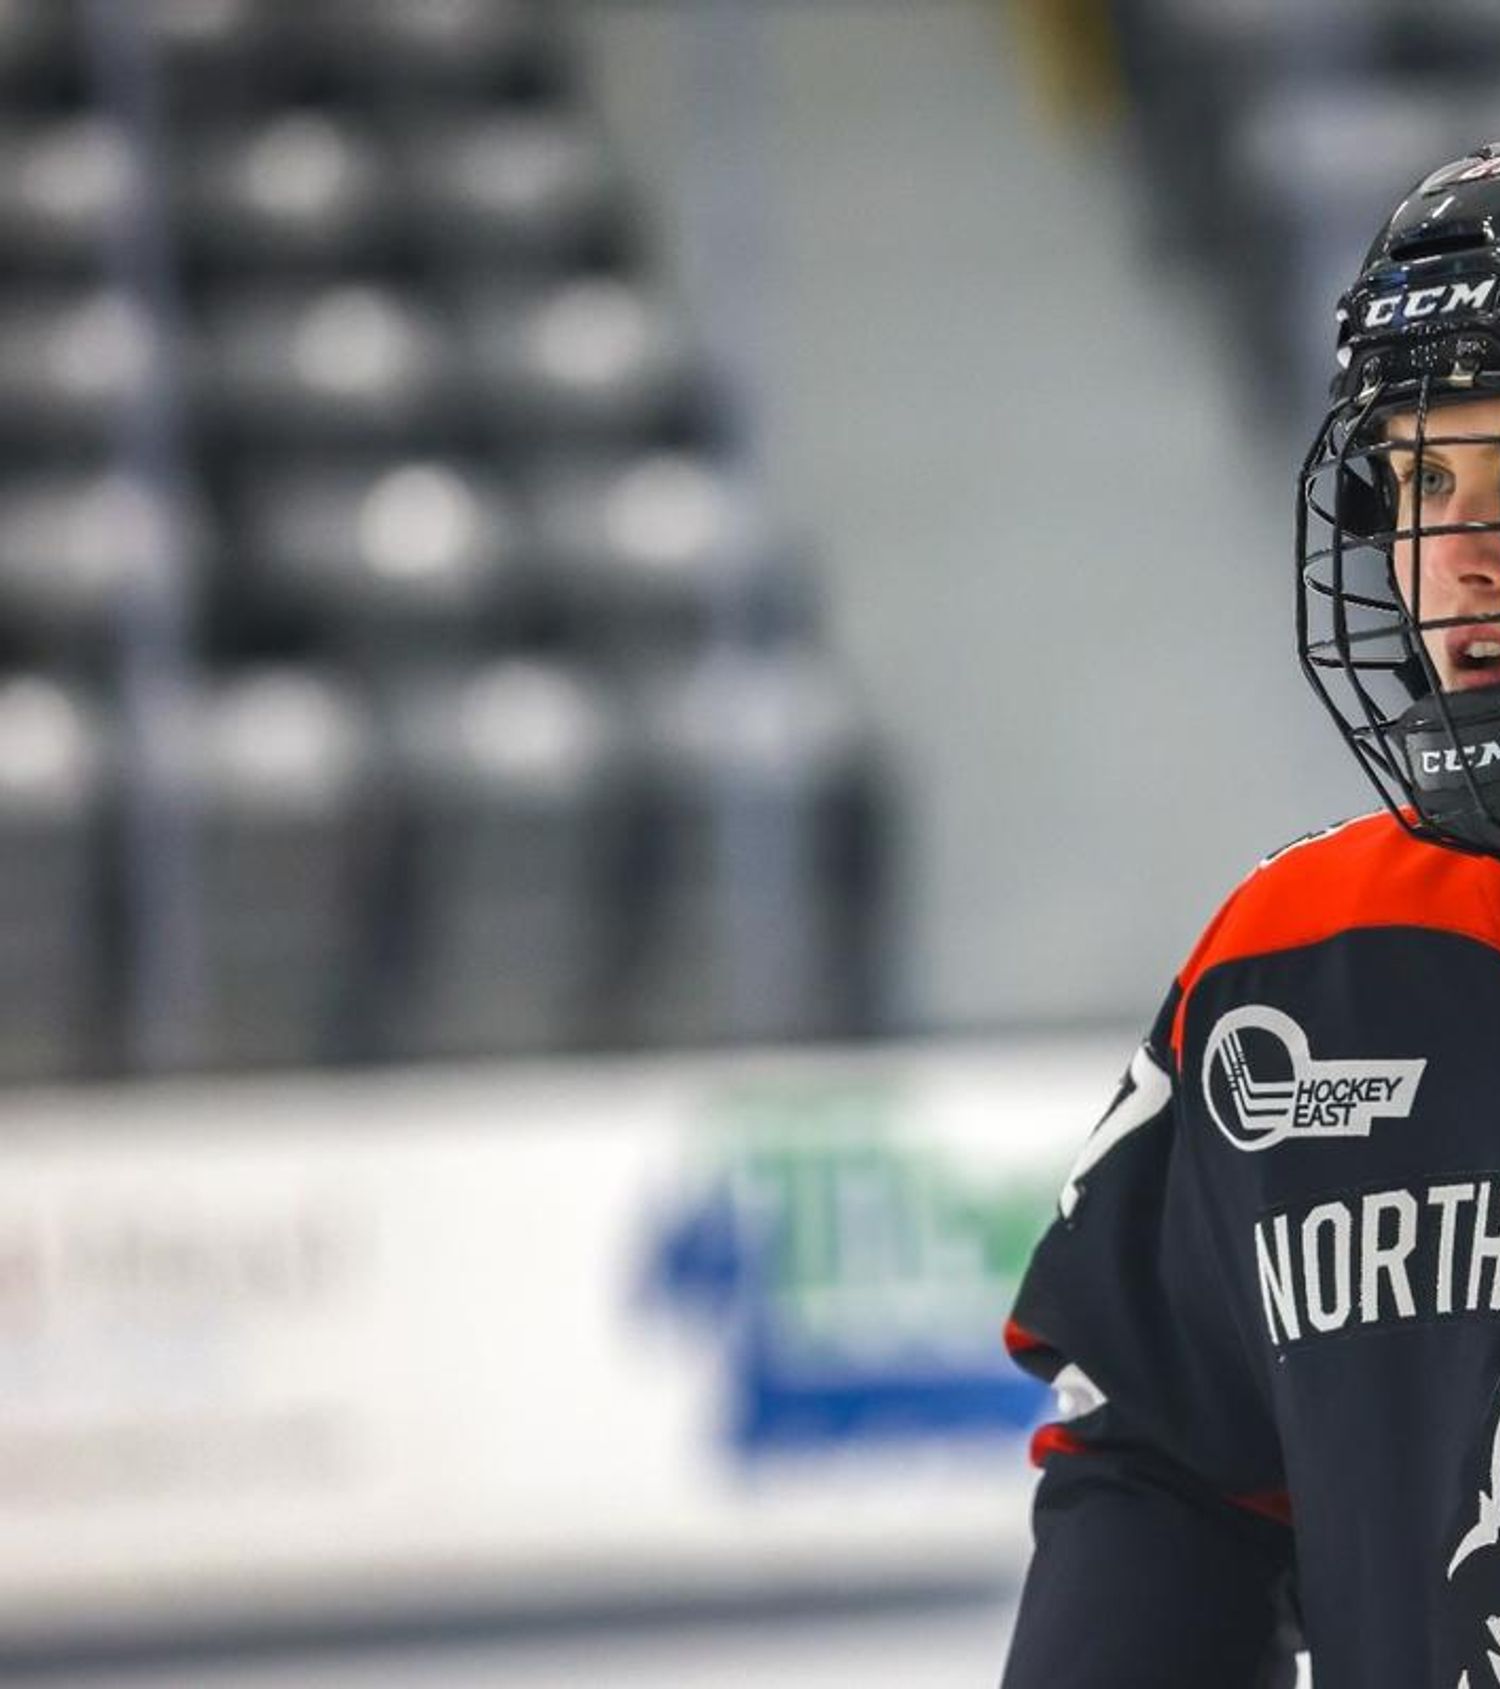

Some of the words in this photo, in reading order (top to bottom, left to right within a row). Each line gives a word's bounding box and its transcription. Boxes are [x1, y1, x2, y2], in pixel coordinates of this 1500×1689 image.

[1364, 279, 1496, 327] CCM
[1297, 1077, 1403, 1103] HOCKEY
[1293, 1103, 1357, 1128] EAST
